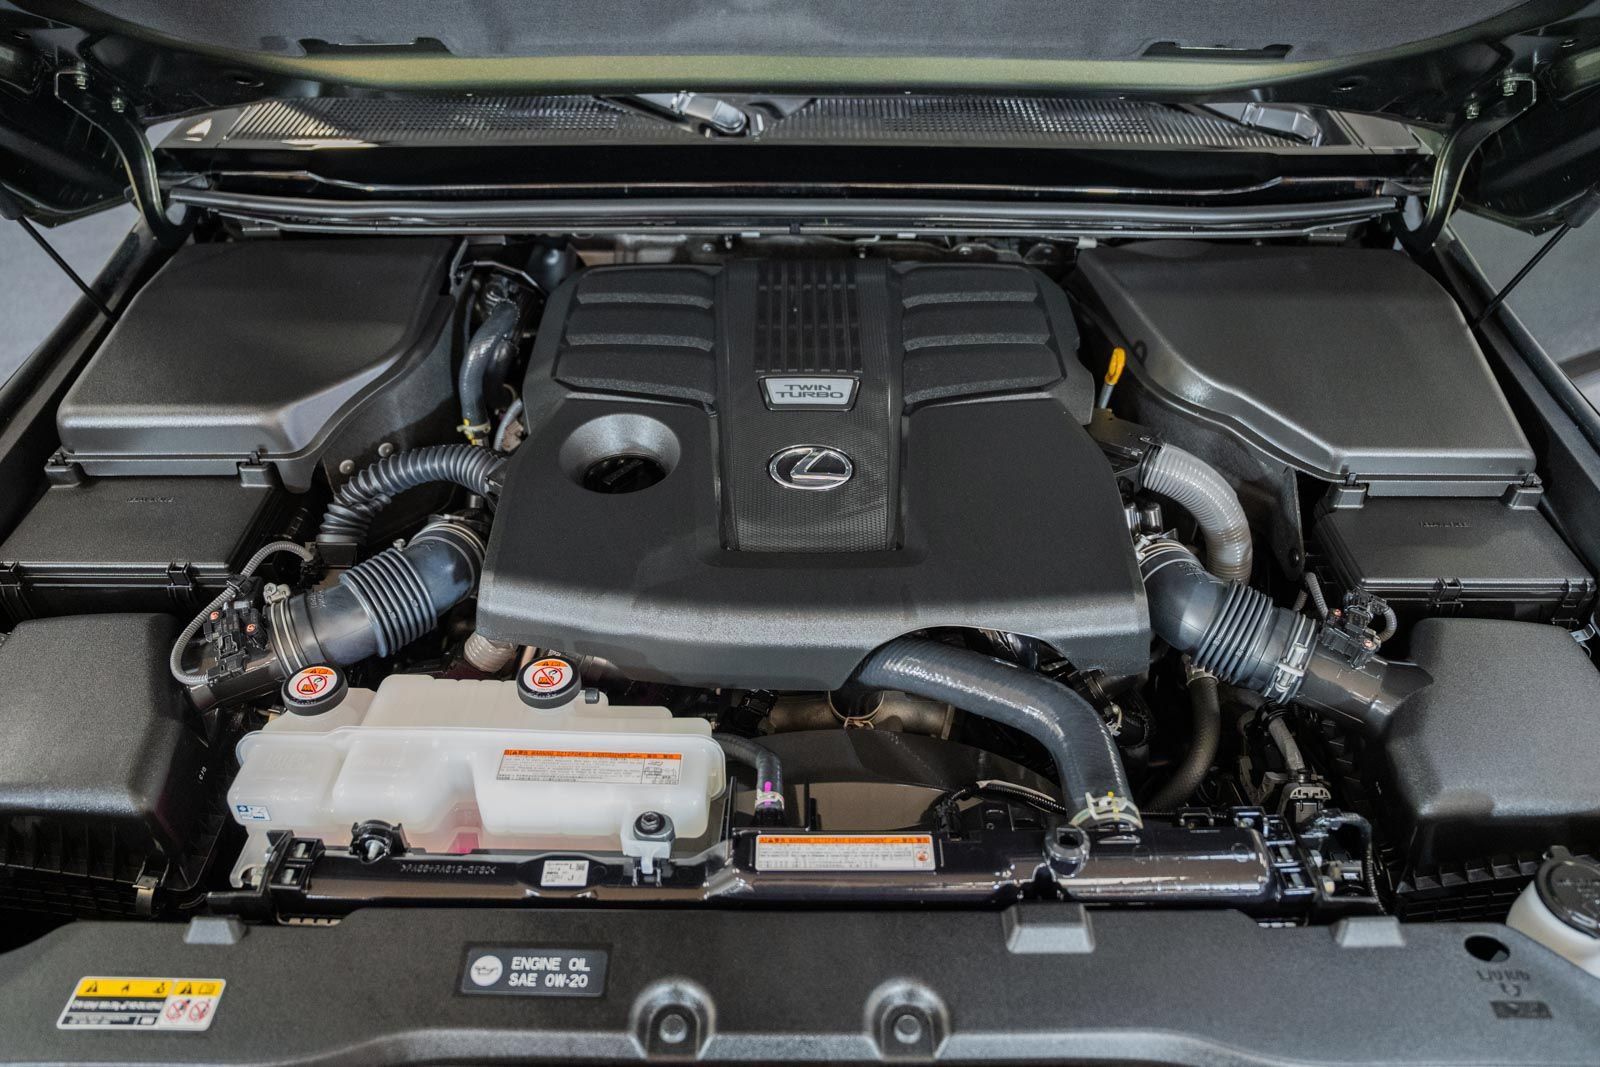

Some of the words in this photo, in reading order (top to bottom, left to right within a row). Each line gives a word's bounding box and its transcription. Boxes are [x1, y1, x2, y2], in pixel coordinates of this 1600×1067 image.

[775, 391, 844, 399] TURBO
[511, 956, 561, 971] ENGINE
[568, 957, 591, 972] OIL
[508, 972, 538, 987] SAE
[544, 973, 588, 988] 0W-20
